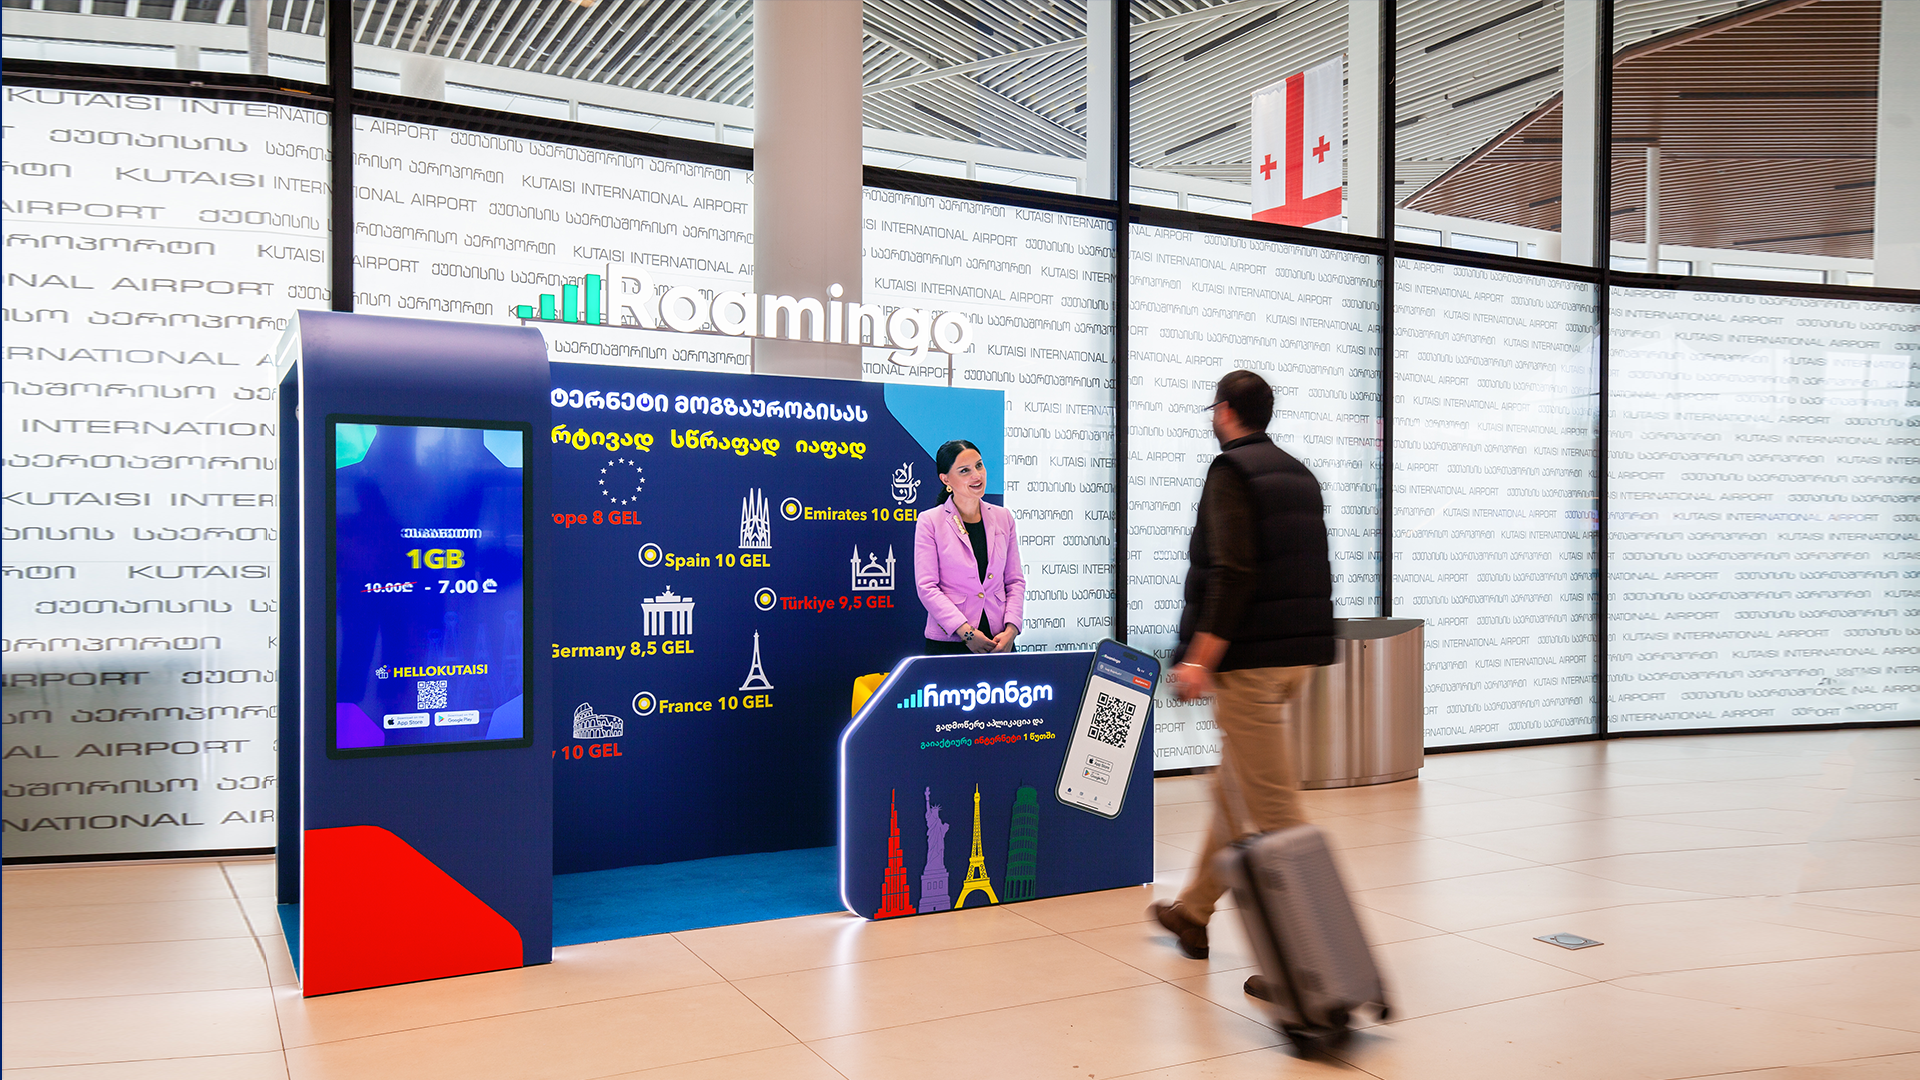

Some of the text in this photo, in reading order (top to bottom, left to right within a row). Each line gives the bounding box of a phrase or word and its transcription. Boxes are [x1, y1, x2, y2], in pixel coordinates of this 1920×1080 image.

[8, 87, 161, 112] KUTAISI
[48, 129, 249, 153] ქუთაისის
[369, 120, 731, 181] AIRPORT ქუთაისის საერთაშორისო აეროპორტი
[115, 167, 265, 188] KUTAISI
[408, 160, 749, 214] აეროპორტი KUTAISI INTERNATIONAL AIRPORT
[198, 209, 320, 231] ქუთაისის
[409, 193, 678, 235] AIRPORT ქუთაისის საერთაშორისო
[938, 199, 1054, 223] აეროპორტი KUTAISI
[881, 220, 1075, 254] INTERNATIONAL AIRPORT ქუთაისის
[1154, 227, 1371, 264] AIRPORT ქუთაისის საერთაშორისო აეროპორტი
[257, 244, 325, 264] KUTAISI
[463, 234, 734, 275] აეროპორტი KUTAISI INTERNATIONAL
[870, 247, 1079, 280] საერთაშორისო აეროპორტი KUTAISI
[431, 263, 506, 281] ქუთაისის
[1156, 254, 1316, 281] INTERNATIONAL AIRPORT ქუთაისის
[1413, 261, 1445, 275] AIRPORT
[110, 277, 275, 296] AIRPORT
[874, 277, 1109, 312] KUTAISI INTERNATIONAL AIRPORT ქუთაისის
[397, 296, 494, 315] აეროპორტი
[1191, 282, 1380, 312] KUTAISI INTERNATIONAL AIRPORT ქუთაისის
[606, 262, 973, 367] Roamingo
[987, 315, 1071, 331] საერთაშორისო
[1201, 308, 1364, 332] აეროპორტი KUTAISI INTERNATIONAL
[1443, 310, 1558, 331] KUTAISI INTERNATIONAL AIRPORT
[554, 340, 668, 360] საერთაშორისო
[1159, 329, 1367, 355] ქუთაისის საერთაშორისო აეროპორტი KUTAISI
[987, 344, 1108, 365] KUTAISI INTERNATIONAL
[1184, 355, 1345, 376] AIRPORT ქუთაისის საერთაშორისო
[963, 369, 1100, 390] ქუთაისის საერთაშორისო
[1154, 378, 1189, 389] KUTAISI
[1308, 389, 1348, 399] ქუთაისის
[1412, 396, 1531, 411] KUTAISI INTERNATIONAL AIRPORT
[550, 388, 868, 423] ტერნეტი მოგზაურობისას
[1024, 402, 1062, 413] KUTAISI
[1335, 414, 1371, 423] AIRPORT
[670, 429, 780, 457] სწრაფად
[795, 440, 867, 460] იაფად
[1302, 435, 1334, 445] KUTAISI
[1049, 456, 1087, 467] KUTAISI
[1145, 452, 1187, 462] AIRPORT
[1312, 458, 1364, 469] აეროპორტი
[1027, 481, 1076, 494] ქუთაისის
[1, 492, 151, 506] KUTAISI
[551, 510, 642, 528] ope 8 GEL
[804, 506, 918, 522] Emirates 10 GEL
[1442, 508, 1558, 518] KUTAISI INTERNATIONAL AIRPORT
[1062, 535, 1111, 548] ქუთაისის
[405, 548, 466, 569] 1GB
[665, 552, 771, 571] Spain 10 GEL
[1334, 551, 1365, 560] KUTAISI
[127, 565, 271, 579] KUTAISI
[1041, 564, 1080, 575] KUTAISI
[438, 579, 479, 594] 7.00
[33, 599, 233, 614] ქუთაისის
[779, 595, 894, 613] Türkiye 9,5 GEL
[1334, 596, 1365, 606] KUTAISI
[1076, 616, 1113, 628] KUTAISI
[630, 641, 657, 657] 8,5
[661, 640, 695, 655] GEL
[393, 664, 488, 678] HELLOKUTAISI
[659, 694, 773, 714] France 10 GEL
[923, 680, 1053, 712] როუმინგო
[74, 740, 252, 758] AIRPORT
[974, 733, 1022, 746] ინტერნეტი
[1023, 733, 1028, 741] 1
[561, 742, 623, 760] 10 GEL
